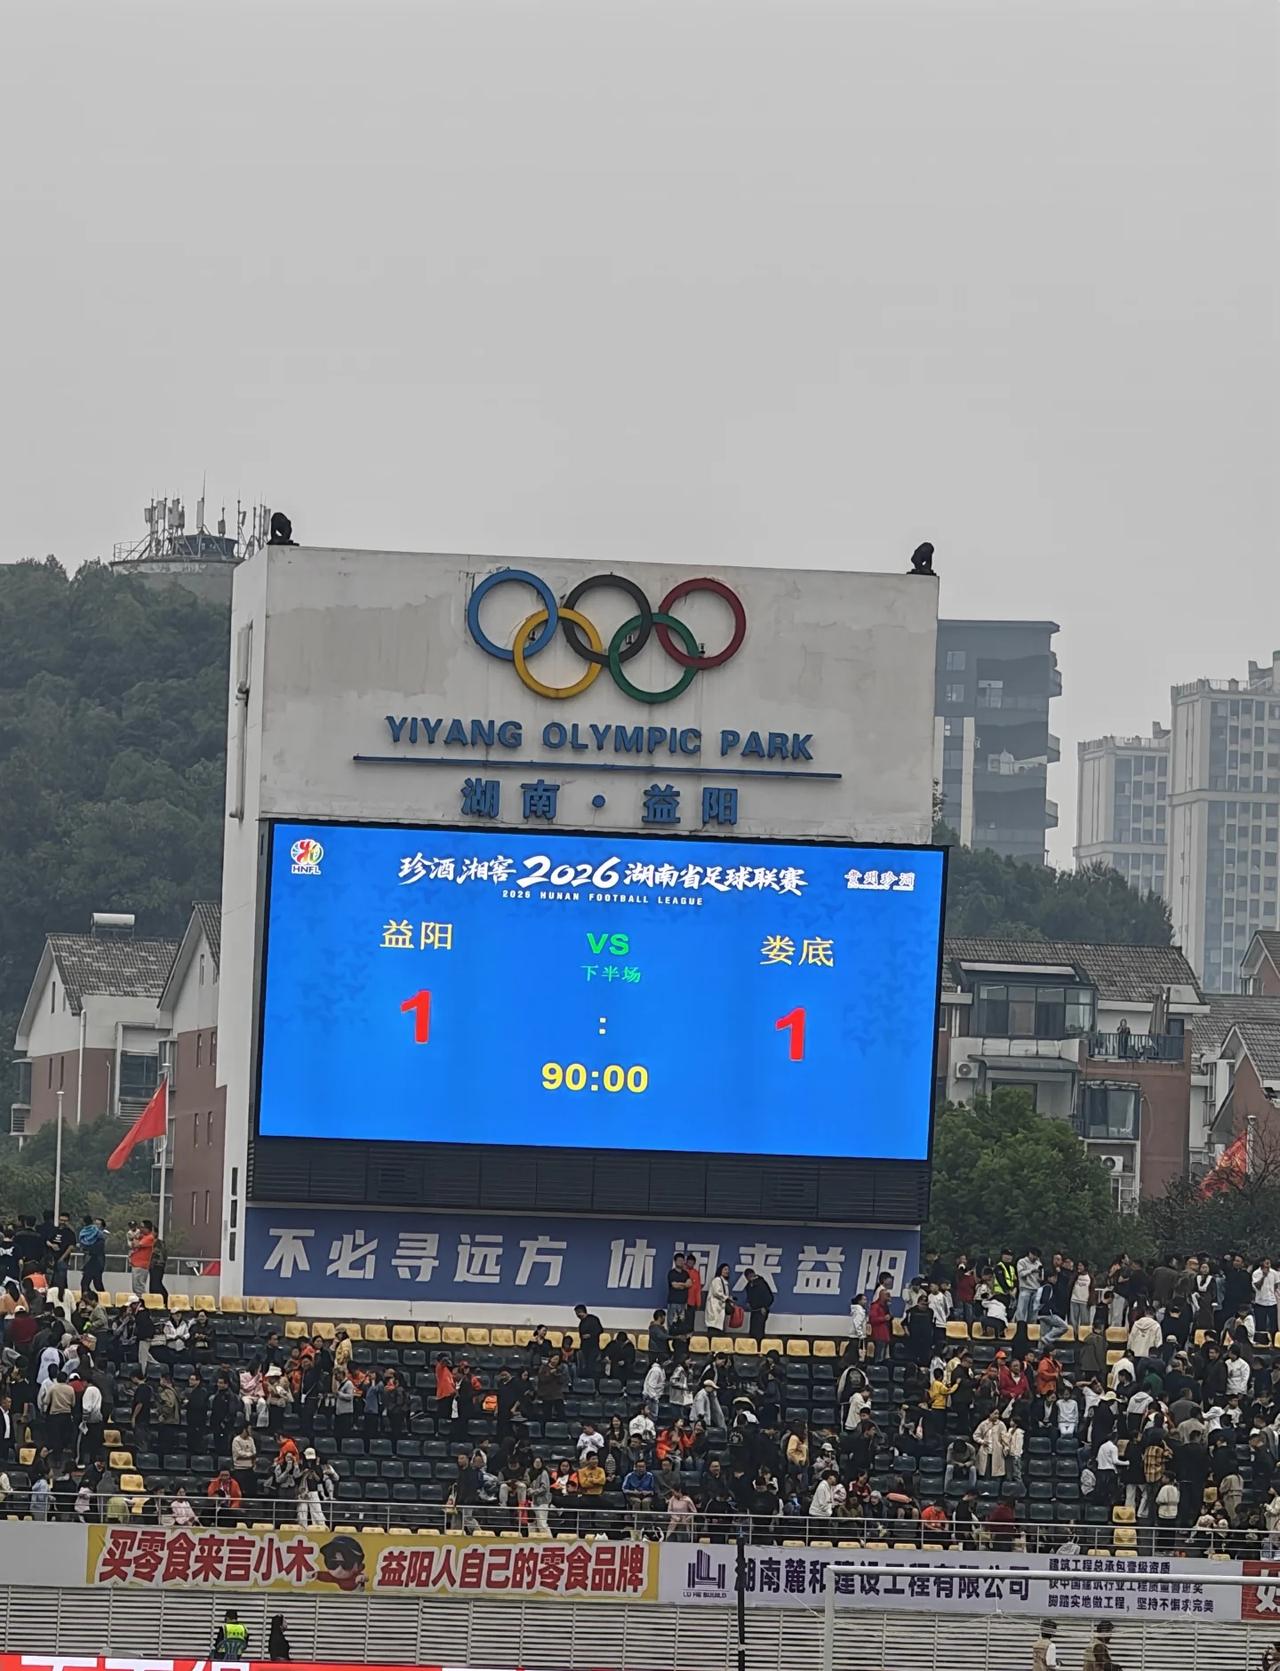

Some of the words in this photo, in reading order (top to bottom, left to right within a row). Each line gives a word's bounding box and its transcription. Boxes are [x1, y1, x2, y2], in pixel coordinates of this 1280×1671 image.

[386, 715, 523, 748] YIYANG
[542, 722, 701, 755] OLYMPIC
[720, 730, 814, 761] PARK
[292, 865, 321, 874] HNFL
[502, 889, 531, 899] 2026
[540, 891, 579, 901] HUNAN
[589, 893, 649, 903] FOOTBALL
[657, 896, 703, 906] LEAGUE
[380, 920, 453, 950] 益阳
[586, 933, 630, 956] VS
[760, 936, 834, 967] 娄底
[580, 964, 641, 984] 下半场
[400, 989, 432, 1044] 1
[775, 1007, 806, 1062] 1
[541, 1062, 648, 1093] 90:00
[264, 1228, 567, 1287] 不必寻远方
[378, 1544, 646, 1592] 益阳人自己的零食品牌
